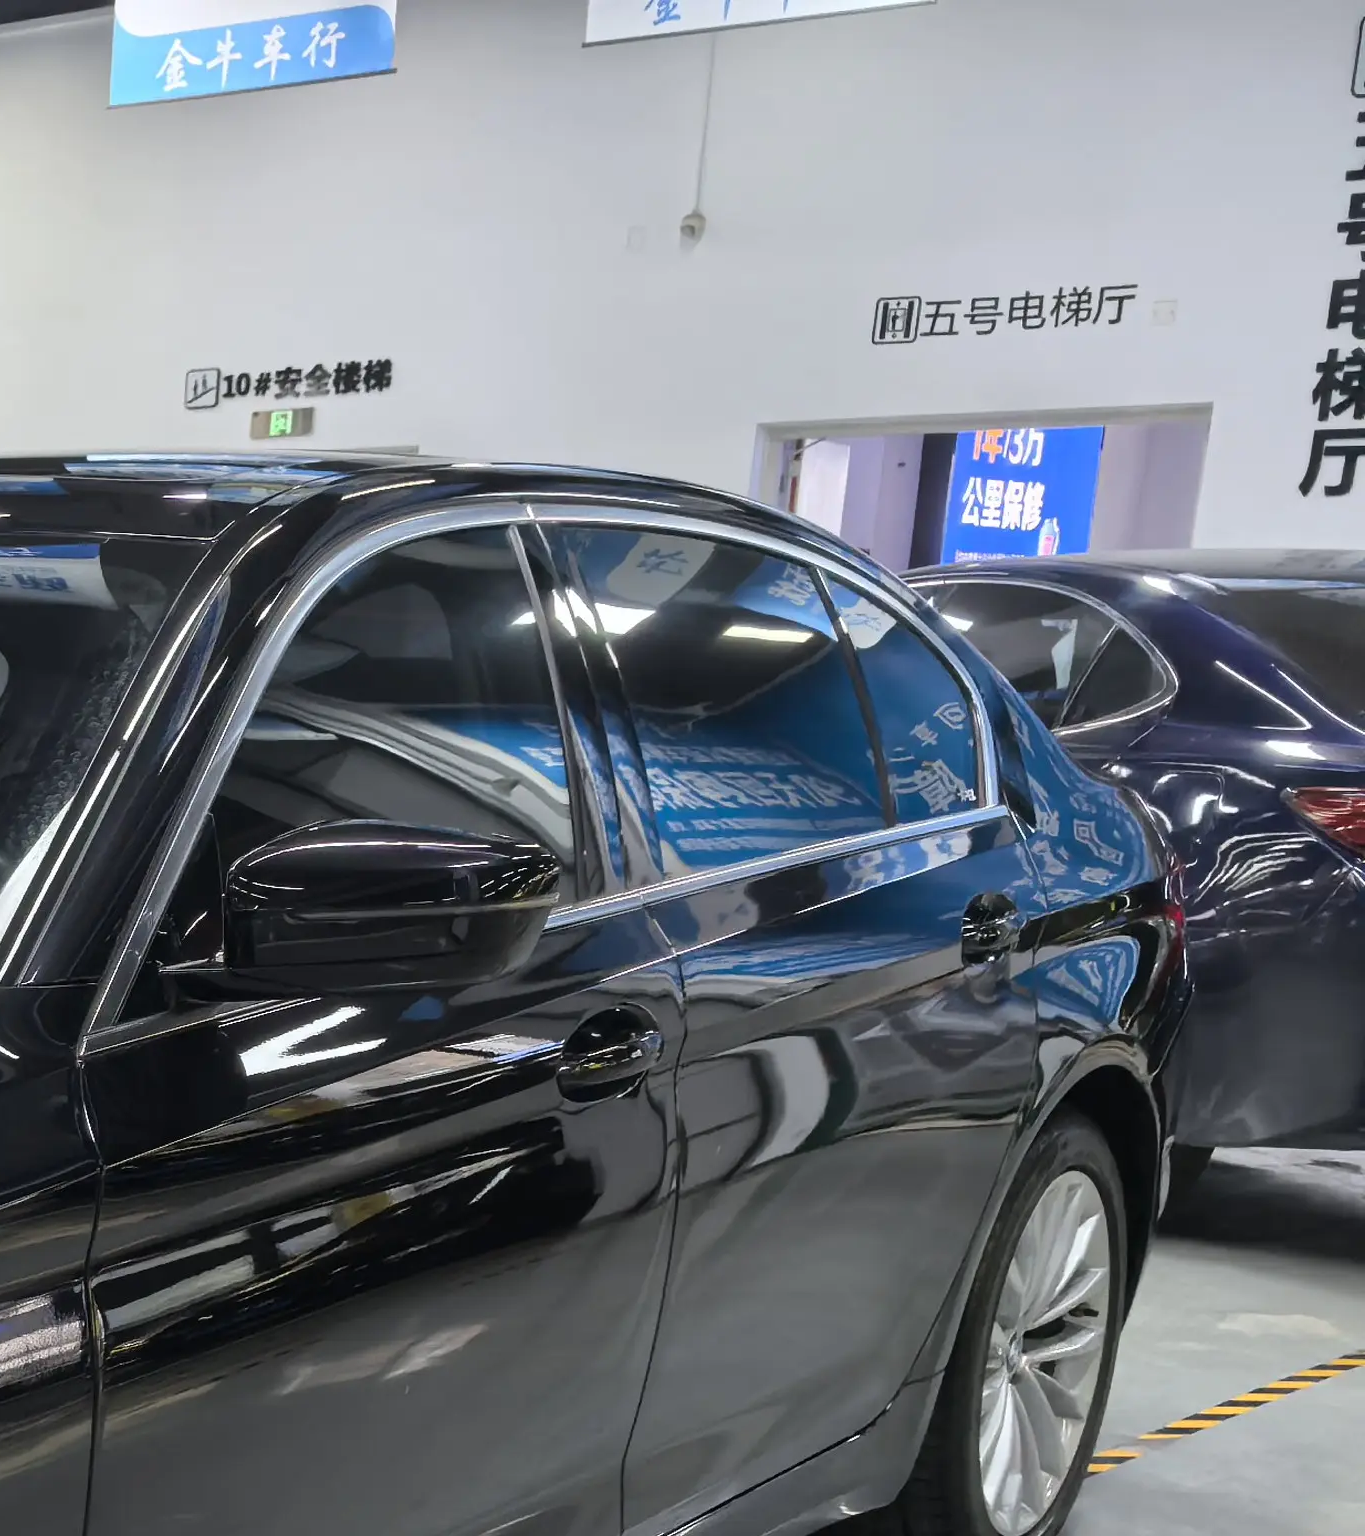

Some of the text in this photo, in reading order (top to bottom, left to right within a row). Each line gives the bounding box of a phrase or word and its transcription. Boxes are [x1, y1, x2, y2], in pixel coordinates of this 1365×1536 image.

[155, 21, 346, 92] 金牛车行
[919, 283, 1139, 337] 五号电梯厅
[222, 358, 393, 400] 10#安全楼梯
[961, 476, 1046, 532] 公里保修
